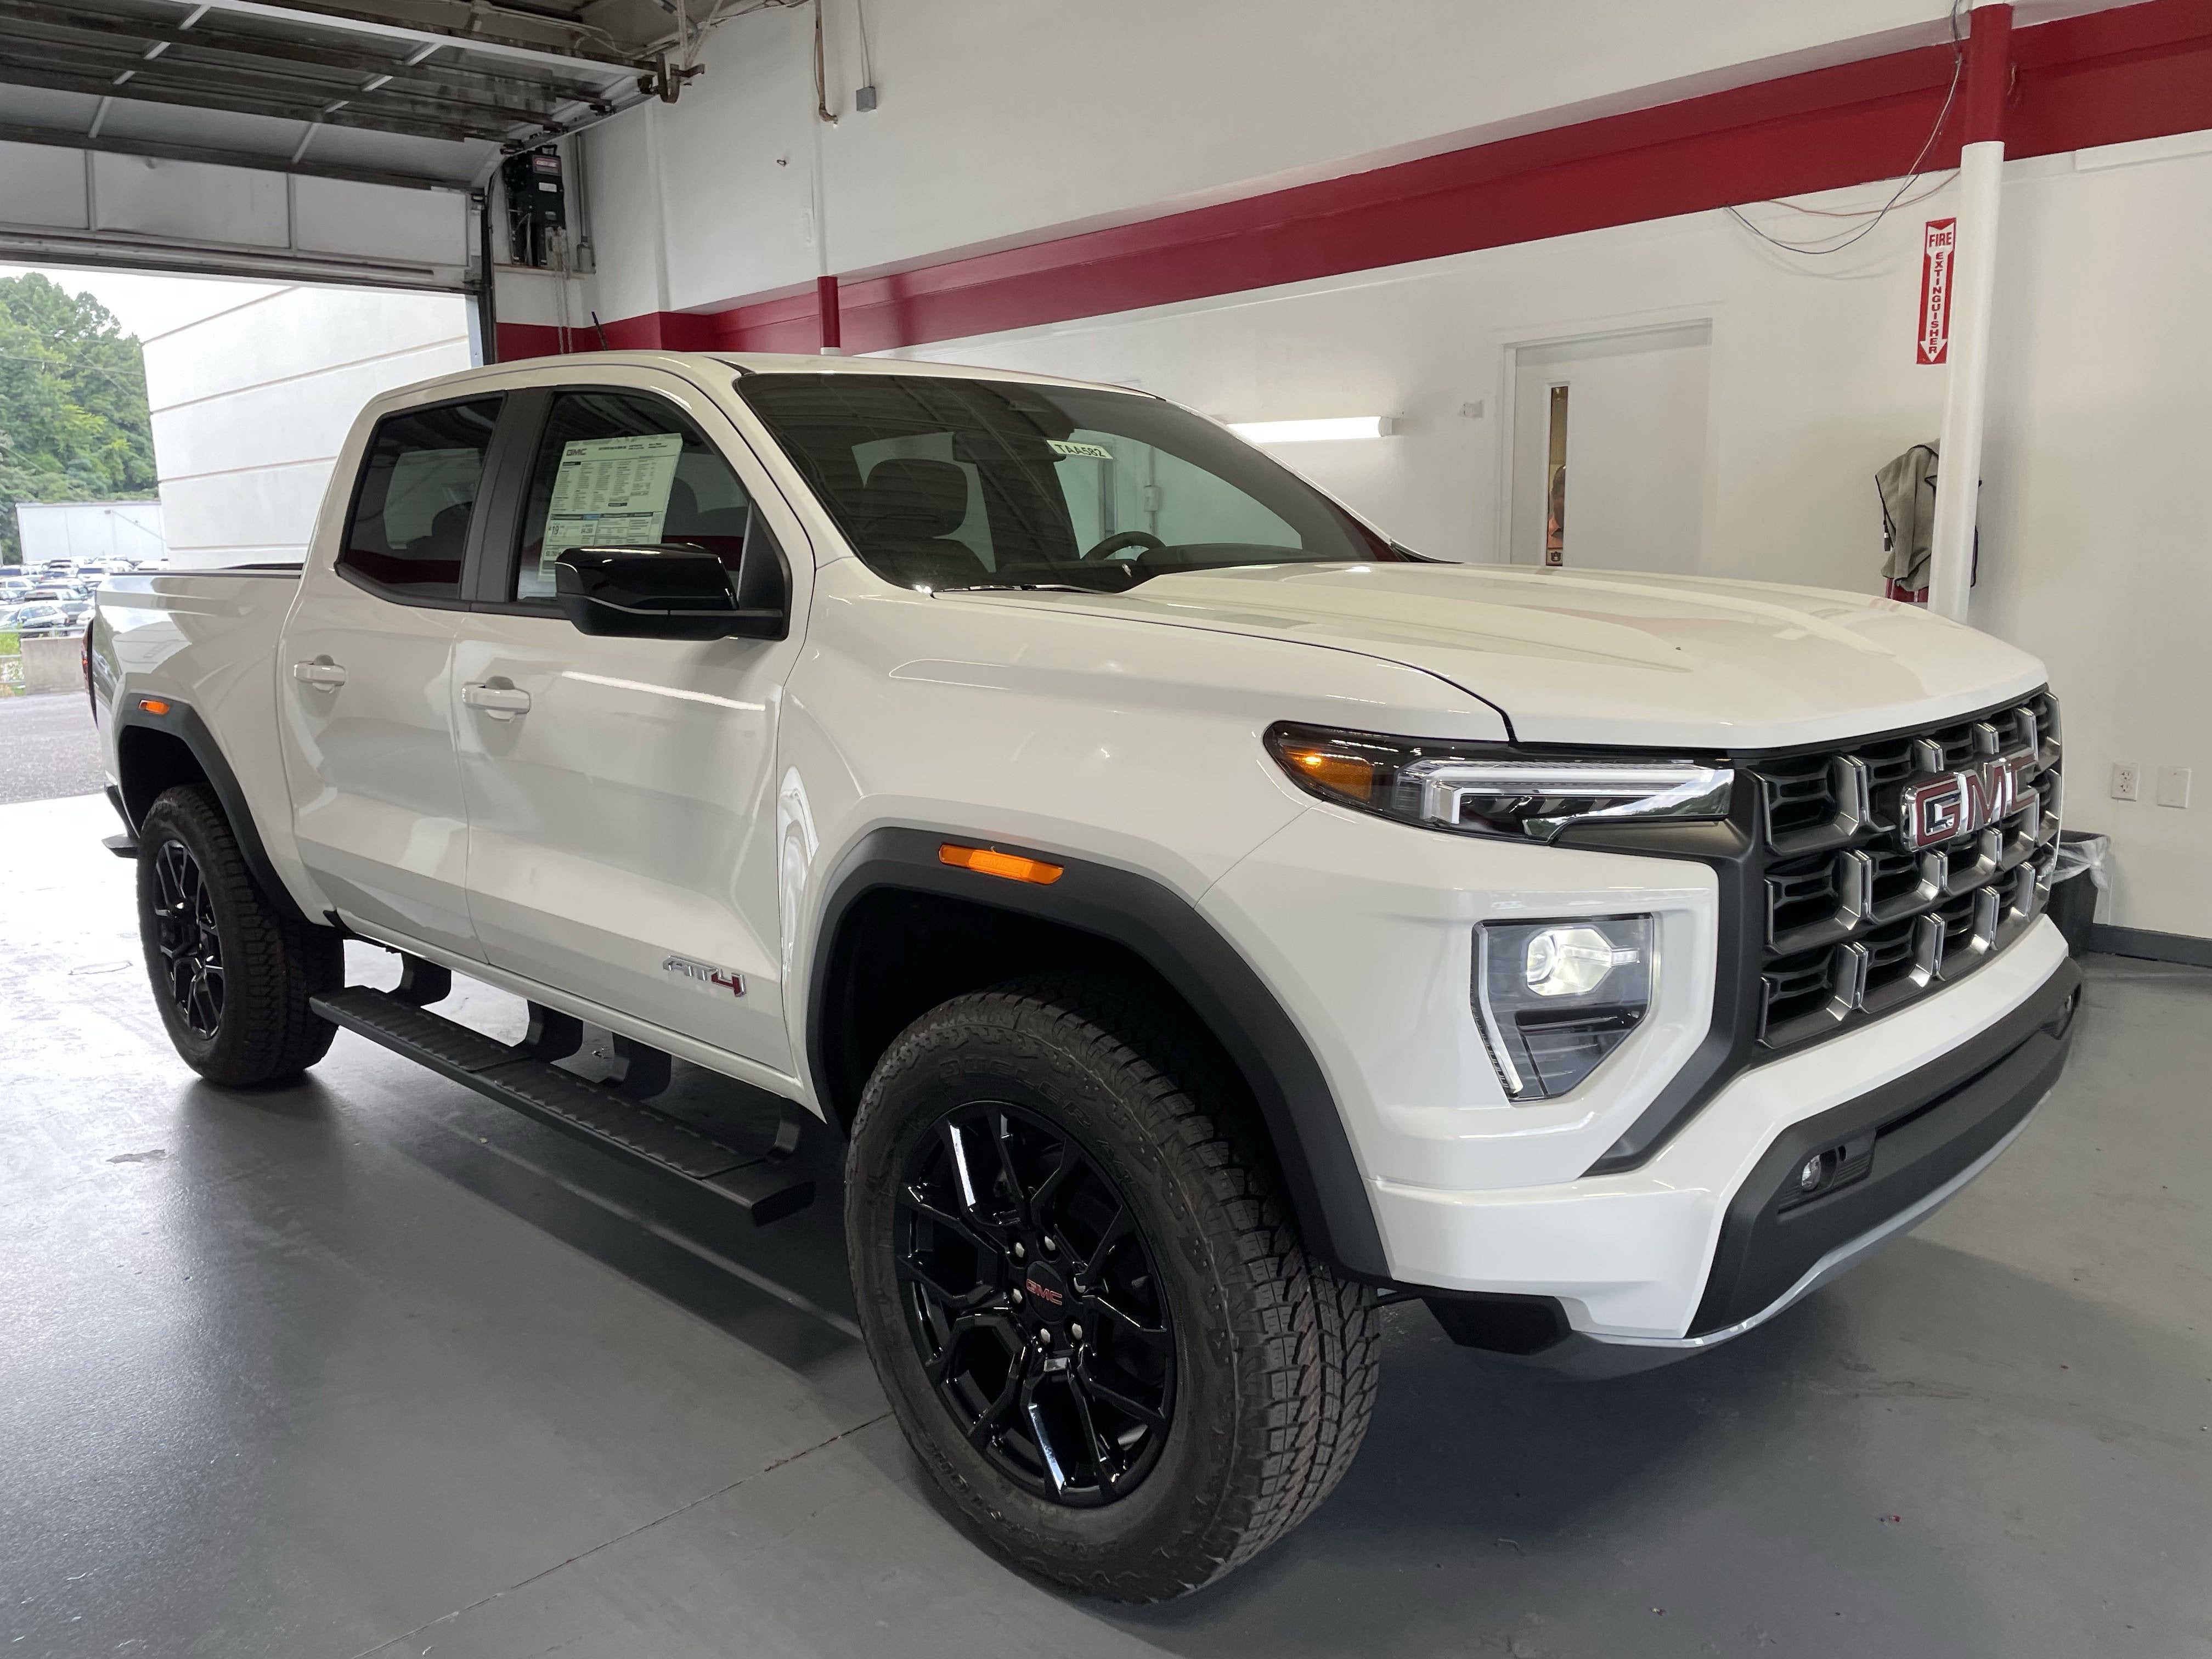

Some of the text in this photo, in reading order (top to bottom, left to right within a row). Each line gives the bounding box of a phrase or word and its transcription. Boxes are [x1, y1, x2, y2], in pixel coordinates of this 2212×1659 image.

[1928, 232, 1952, 247] FIRE
[1928, 252, 1944, 354] EXTINGUISHER
[566, 448, 587, 456] GMC
[1054, 444, 1107, 457] TAA582
[1901, 745, 2038, 852] GMC
[662, 955, 747, 997] AT4
[1026, 1278, 1063, 1306] GMC
